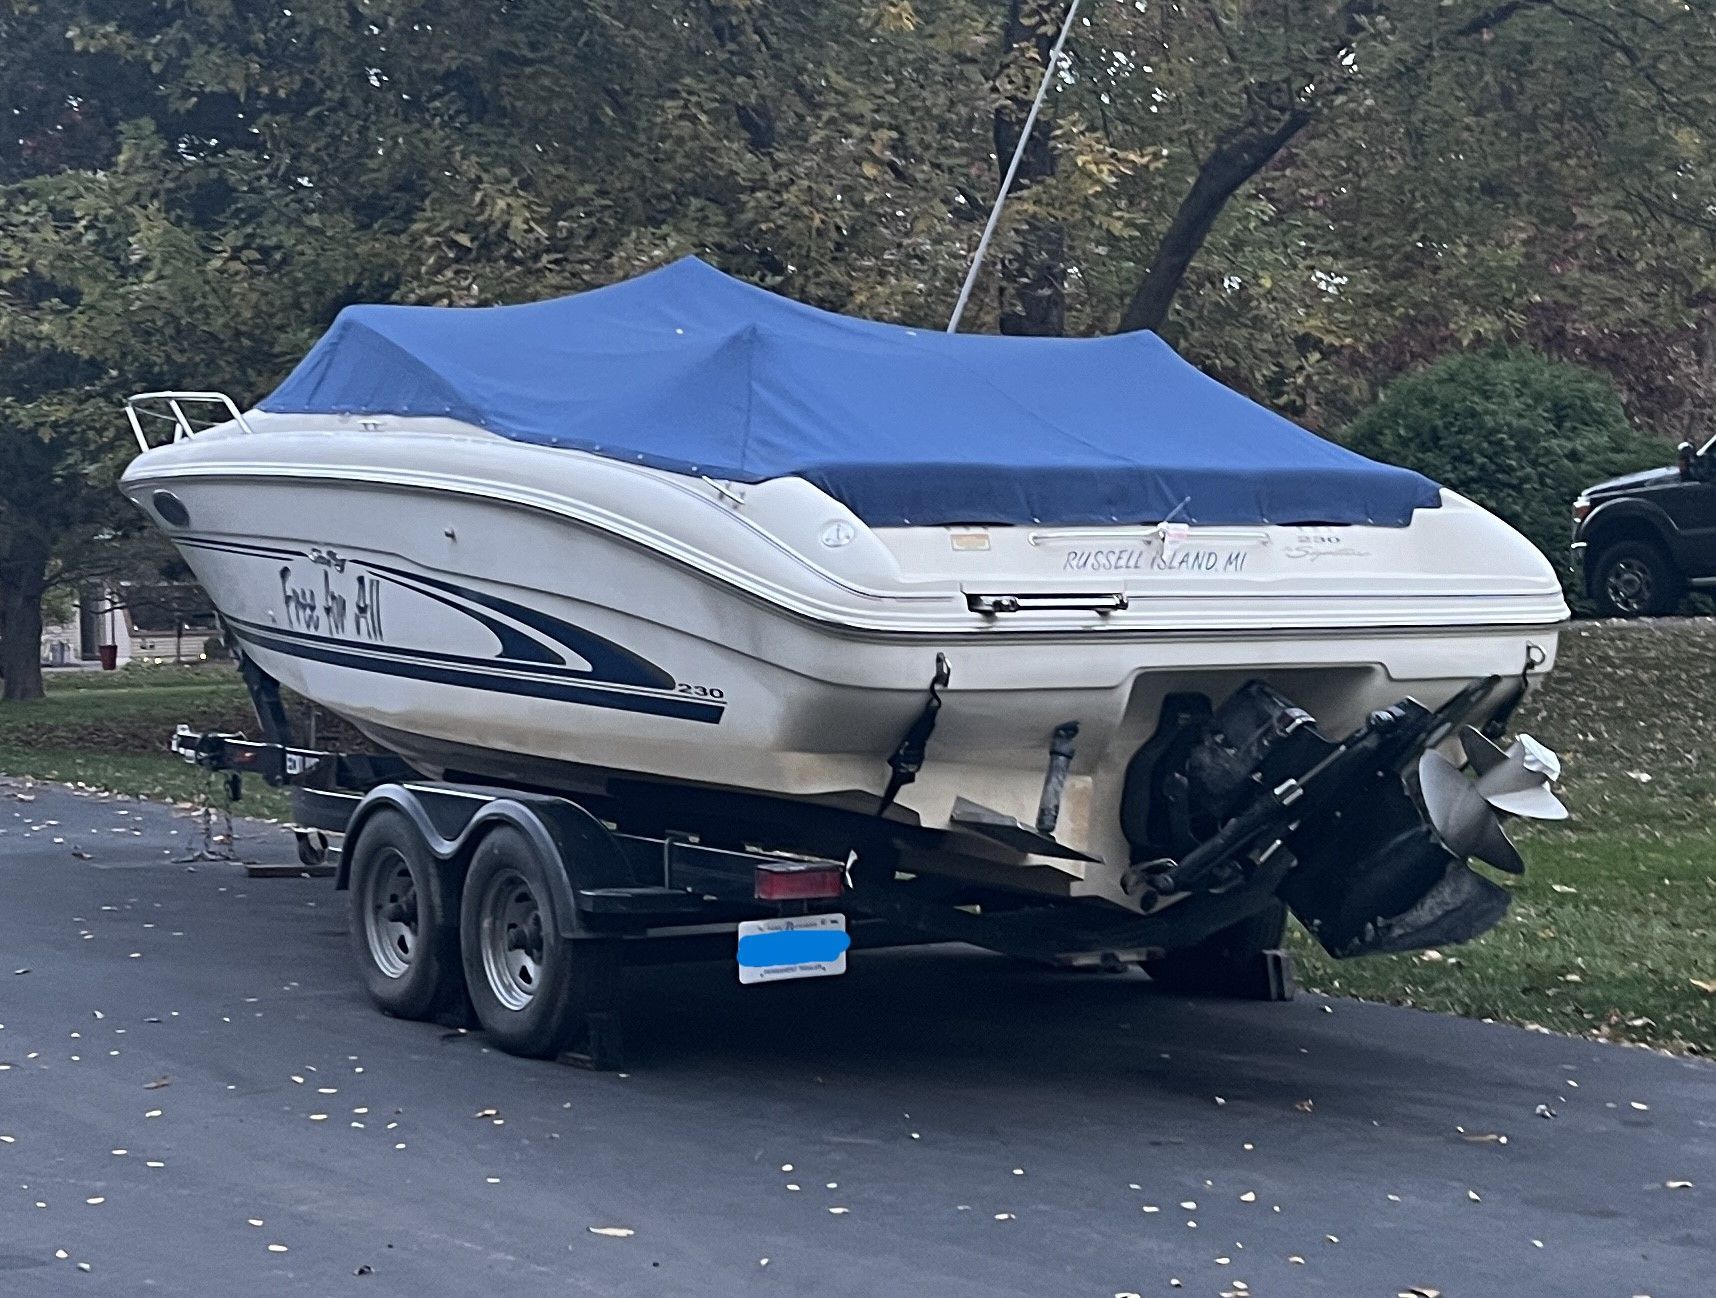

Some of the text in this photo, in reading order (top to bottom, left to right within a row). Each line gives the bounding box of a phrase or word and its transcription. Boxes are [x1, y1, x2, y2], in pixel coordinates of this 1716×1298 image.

[1063, 550, 1144, 571] RUSSELL
[1223, 551, 1248, 572] MI
[354, 575, 384, 641] All
[677, 682, 724, 699] 230
